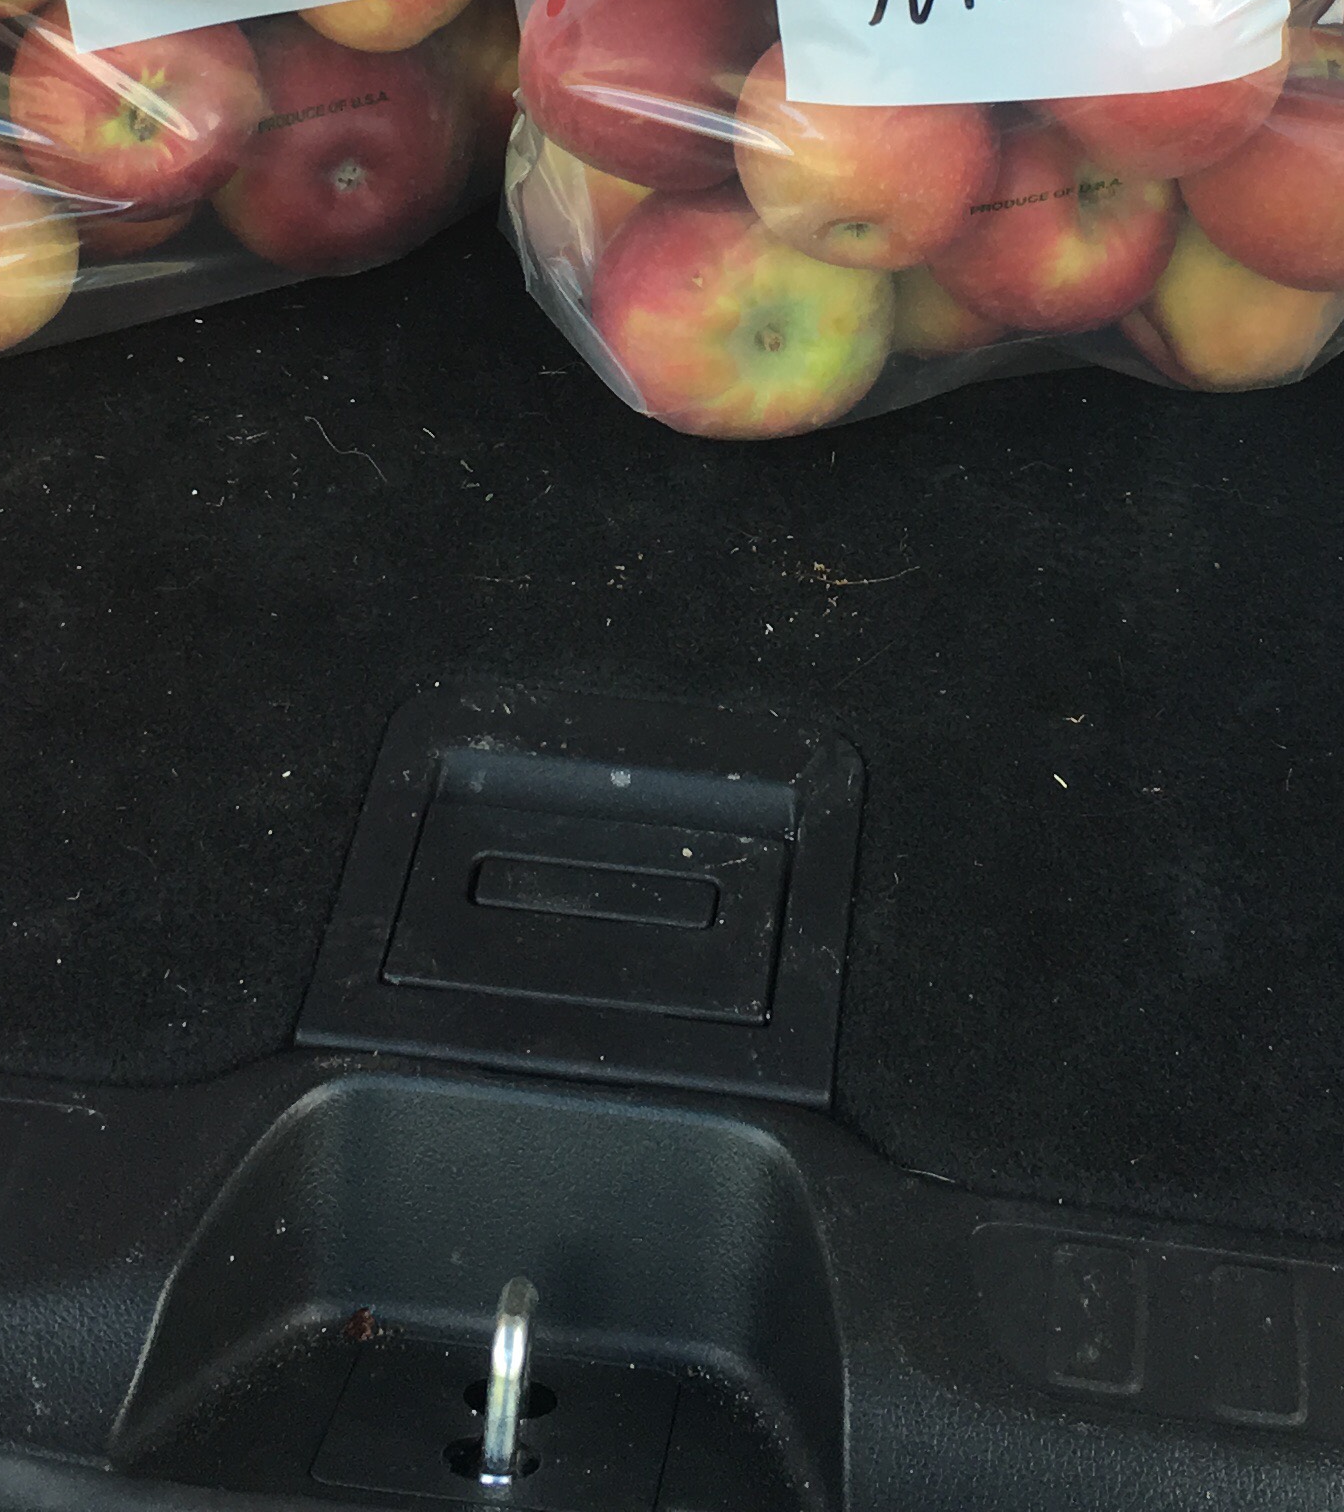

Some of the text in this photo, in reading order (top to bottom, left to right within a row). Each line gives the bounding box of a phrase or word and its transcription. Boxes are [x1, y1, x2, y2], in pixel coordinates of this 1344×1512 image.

[329, 100, 347, 113] OF
[970, 192, 1049, 215] PRODUCE
[1054, 186, 1074, 198] OF
